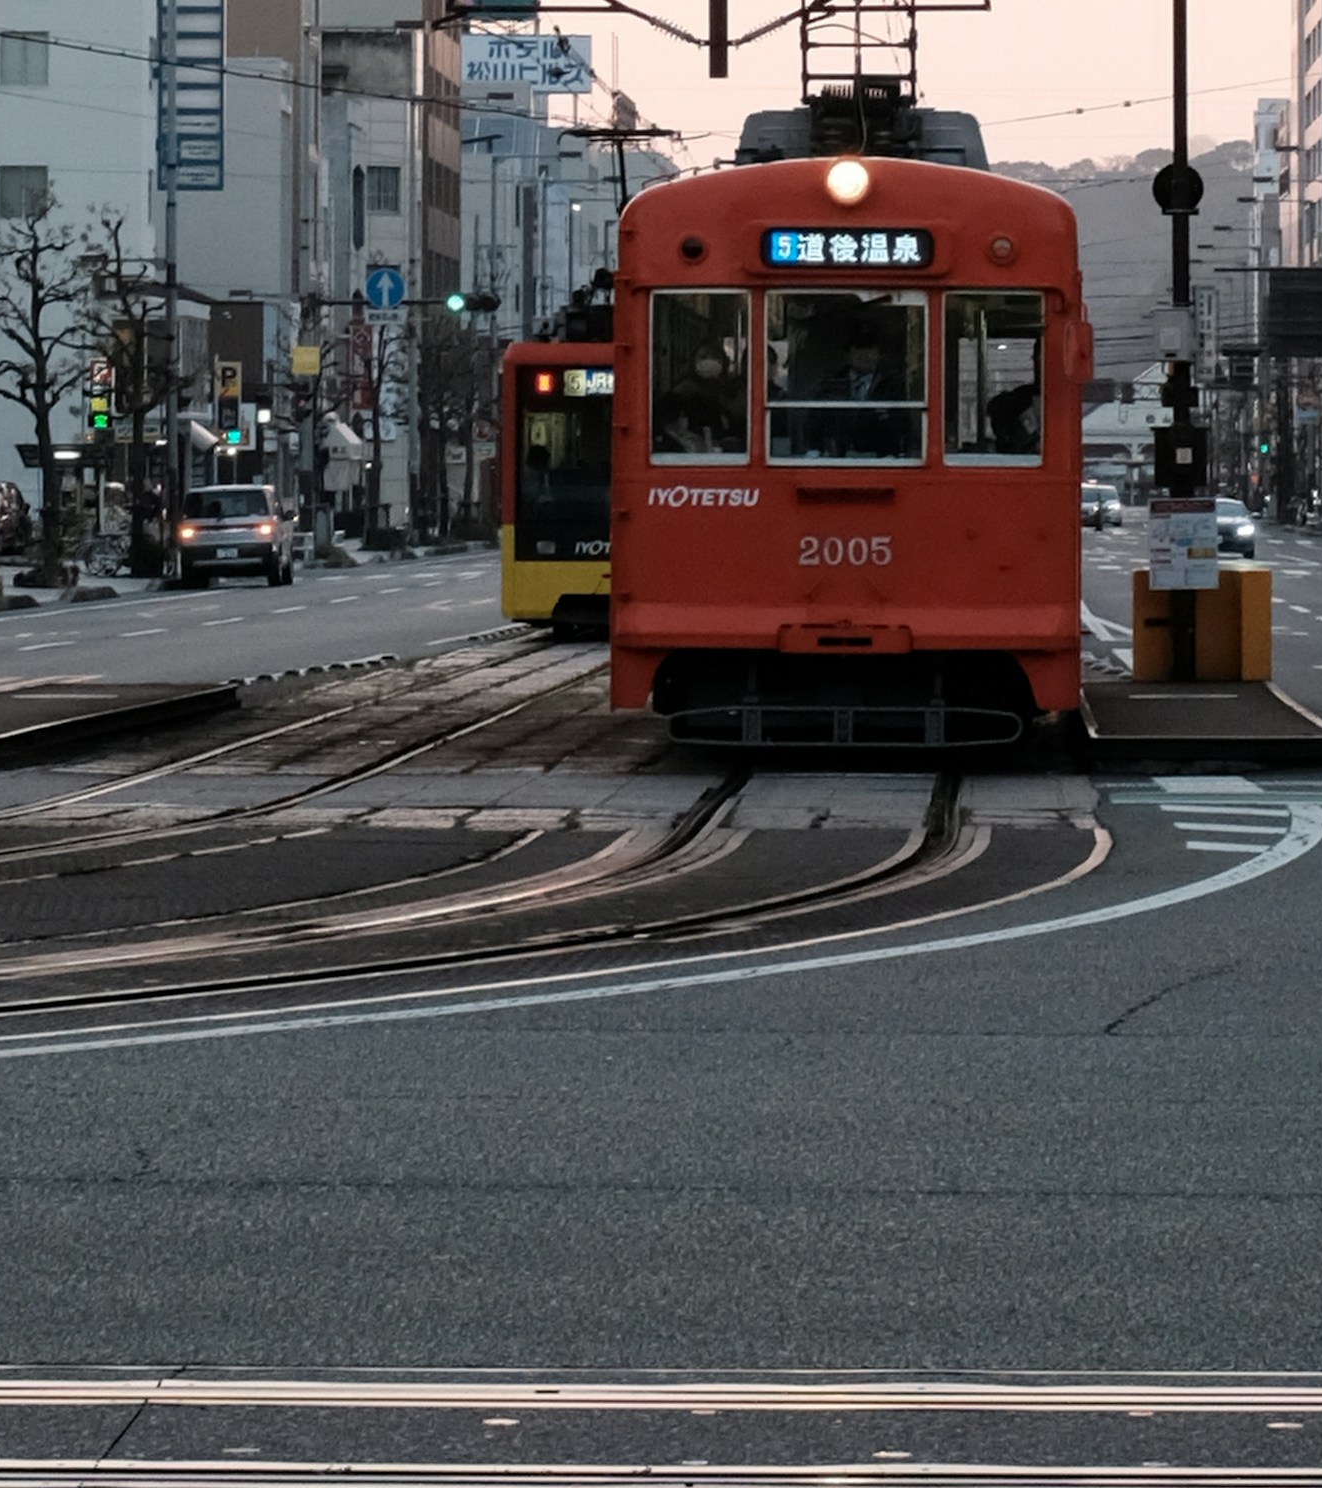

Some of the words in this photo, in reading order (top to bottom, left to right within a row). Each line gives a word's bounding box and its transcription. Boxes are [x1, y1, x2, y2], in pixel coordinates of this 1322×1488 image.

[488, 40, 563, 59] ホテル
[778, 234, 793, 259] 5
[796, 232, 922, 263] 道後温泉
[221, 367, 237, 387] P
[647, 485, 761, 508] IYOTETSU
[798, 536, 893, 566] 2005
